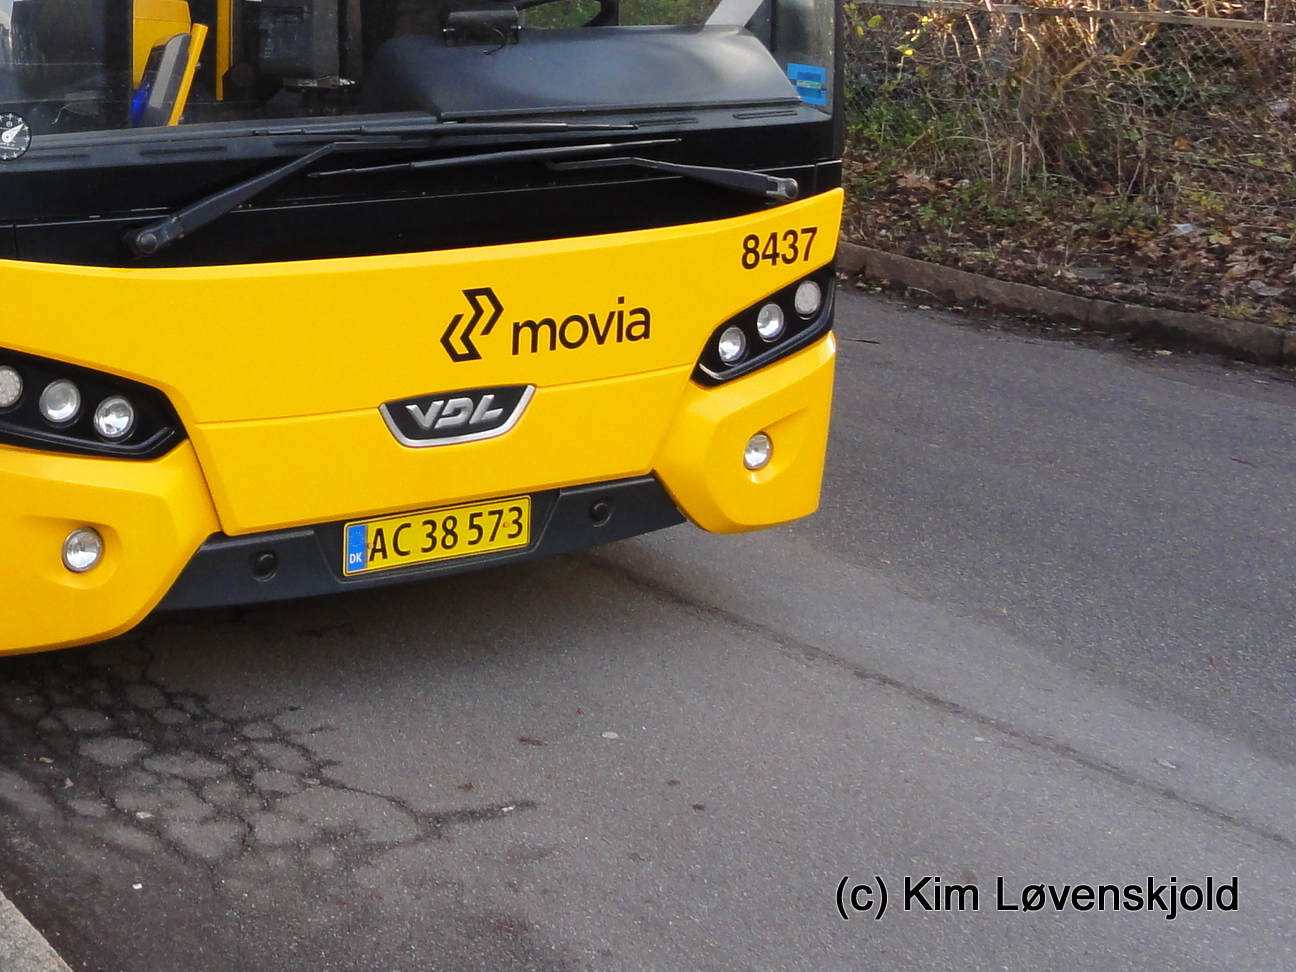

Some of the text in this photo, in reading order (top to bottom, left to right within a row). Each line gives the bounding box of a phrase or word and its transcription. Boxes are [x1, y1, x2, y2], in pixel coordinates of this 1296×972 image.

[740, 226, 819, 270] 8437
[511, 296, 652, 357] movia
[404, 393, 505, 429] VDL
[368, 505, 524, 562] AC 38 573
[349, 552, 363, 564] DK
